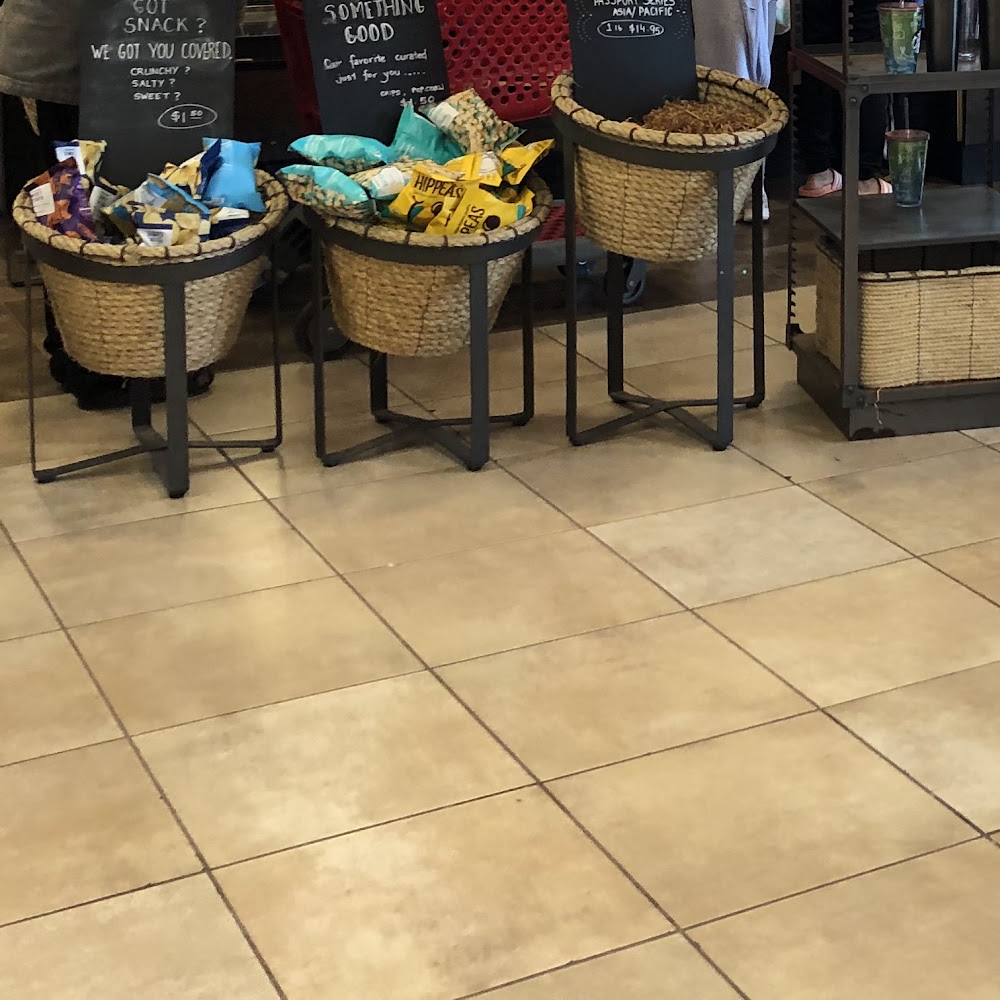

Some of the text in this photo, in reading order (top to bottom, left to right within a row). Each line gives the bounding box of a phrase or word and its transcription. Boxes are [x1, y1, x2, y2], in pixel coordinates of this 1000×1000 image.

[123, 17, 189, 33] SNACK
[344, 22, 394, 44] GOOD
[90, 43, 110, 60] WE
[117, 43, 140, 60] GOT
[148, 42, 175, 59] YOU
[349, 53, 387, 69] favorite
[395, 48, 427, 62] curated
[130, 66, 179, 76] CRUNCHY
[335, 72, 357, 84] just
[362, 69, 377, 81] for
[130, 79, 165, 88] SALTY
[133, 92, 170, 100] SWEET
[413, 174, 464, 199] HIPPEAS
[460, 205, 486, 235] PEAS
